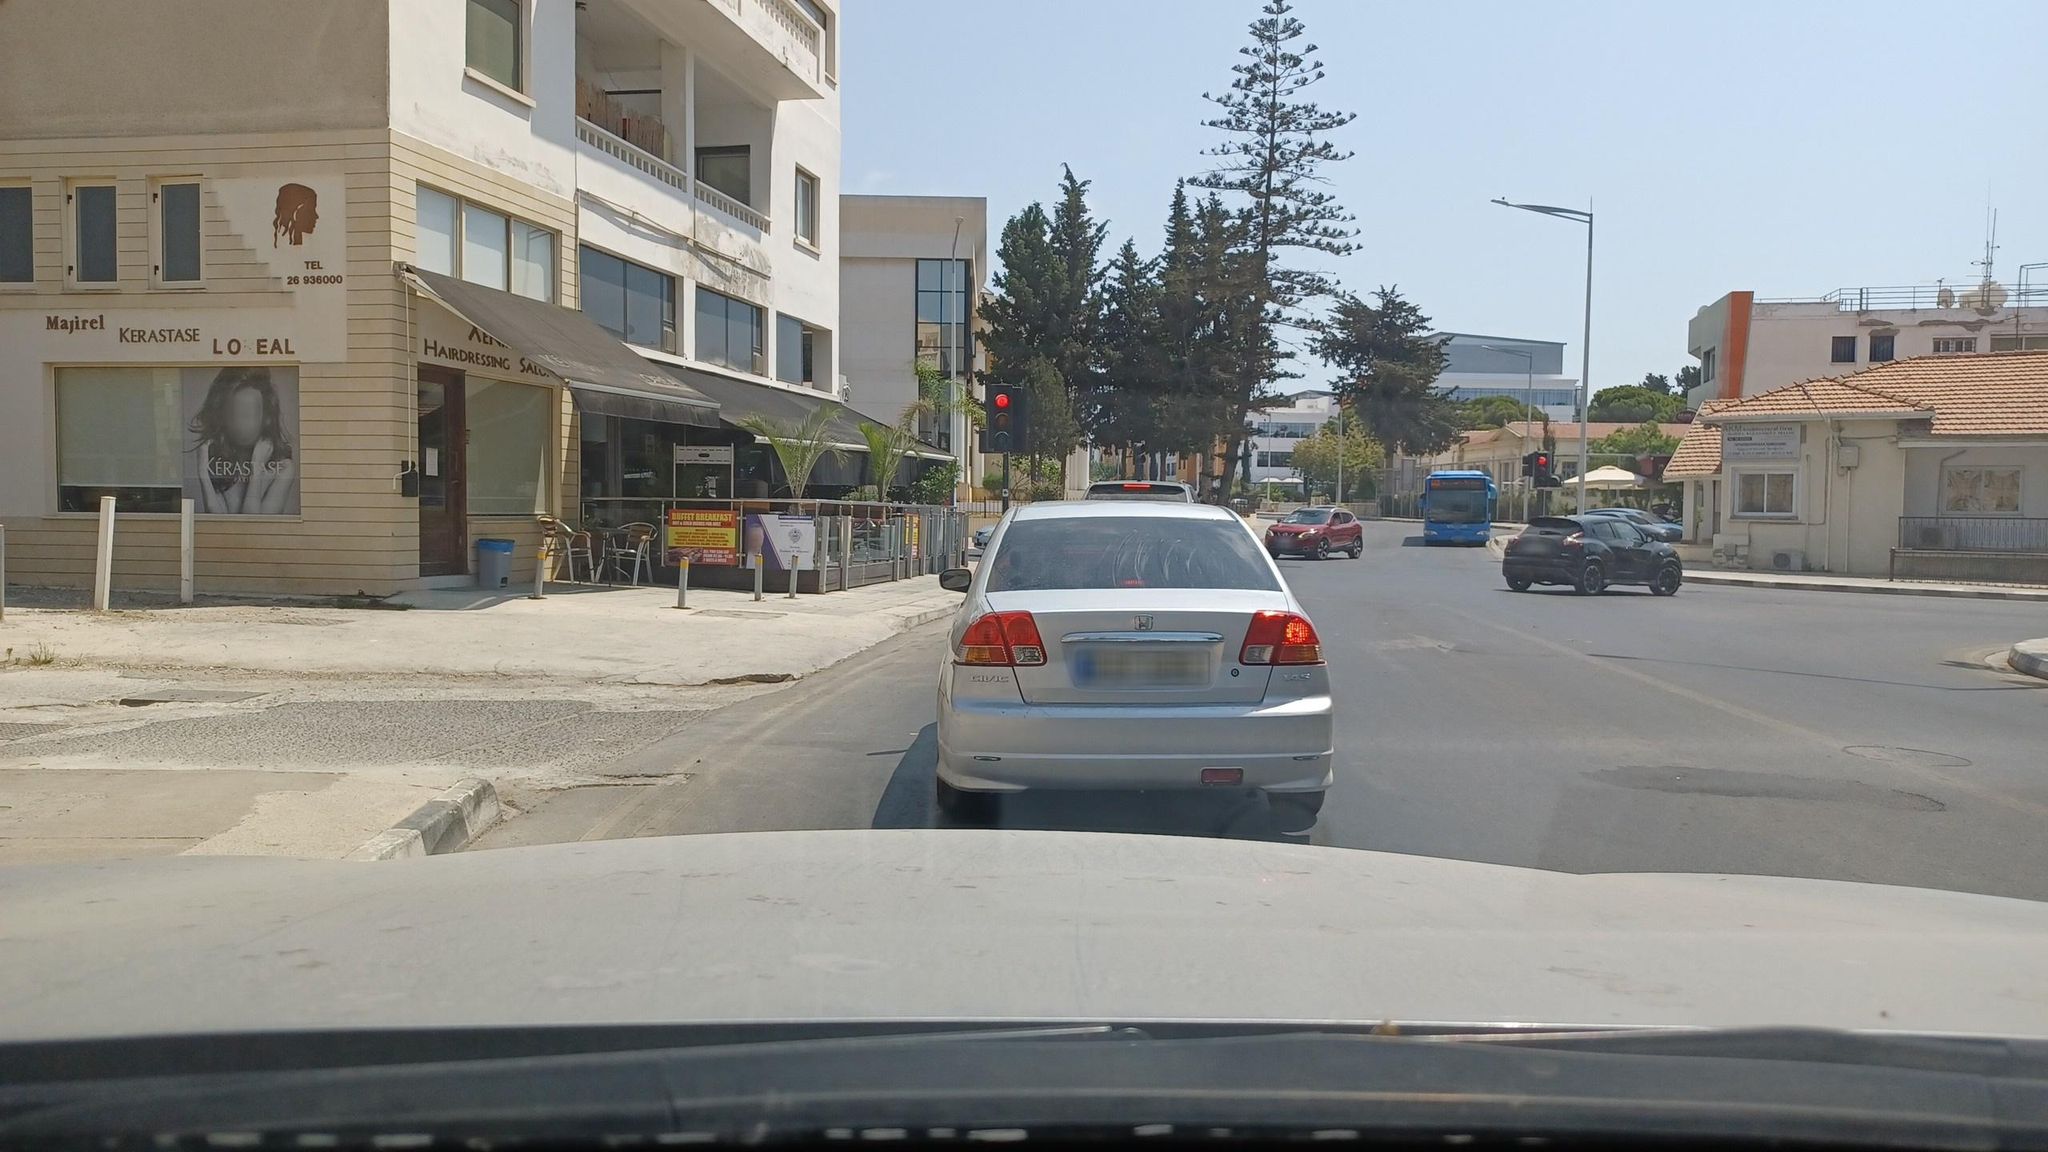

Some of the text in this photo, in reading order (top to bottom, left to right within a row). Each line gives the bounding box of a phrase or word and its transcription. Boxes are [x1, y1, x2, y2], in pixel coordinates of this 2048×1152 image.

[304, 260, 323, 270] TEL
[287, 275, 343, 285] 26 936000
[46, 315, 105, 334] Majirel
[119, 327, 201, 343] KERASTASE
[424, 338, 511, 371] HAIRDRESSING
[671, 512, 733, 522] BUFFET BREAKFAST
